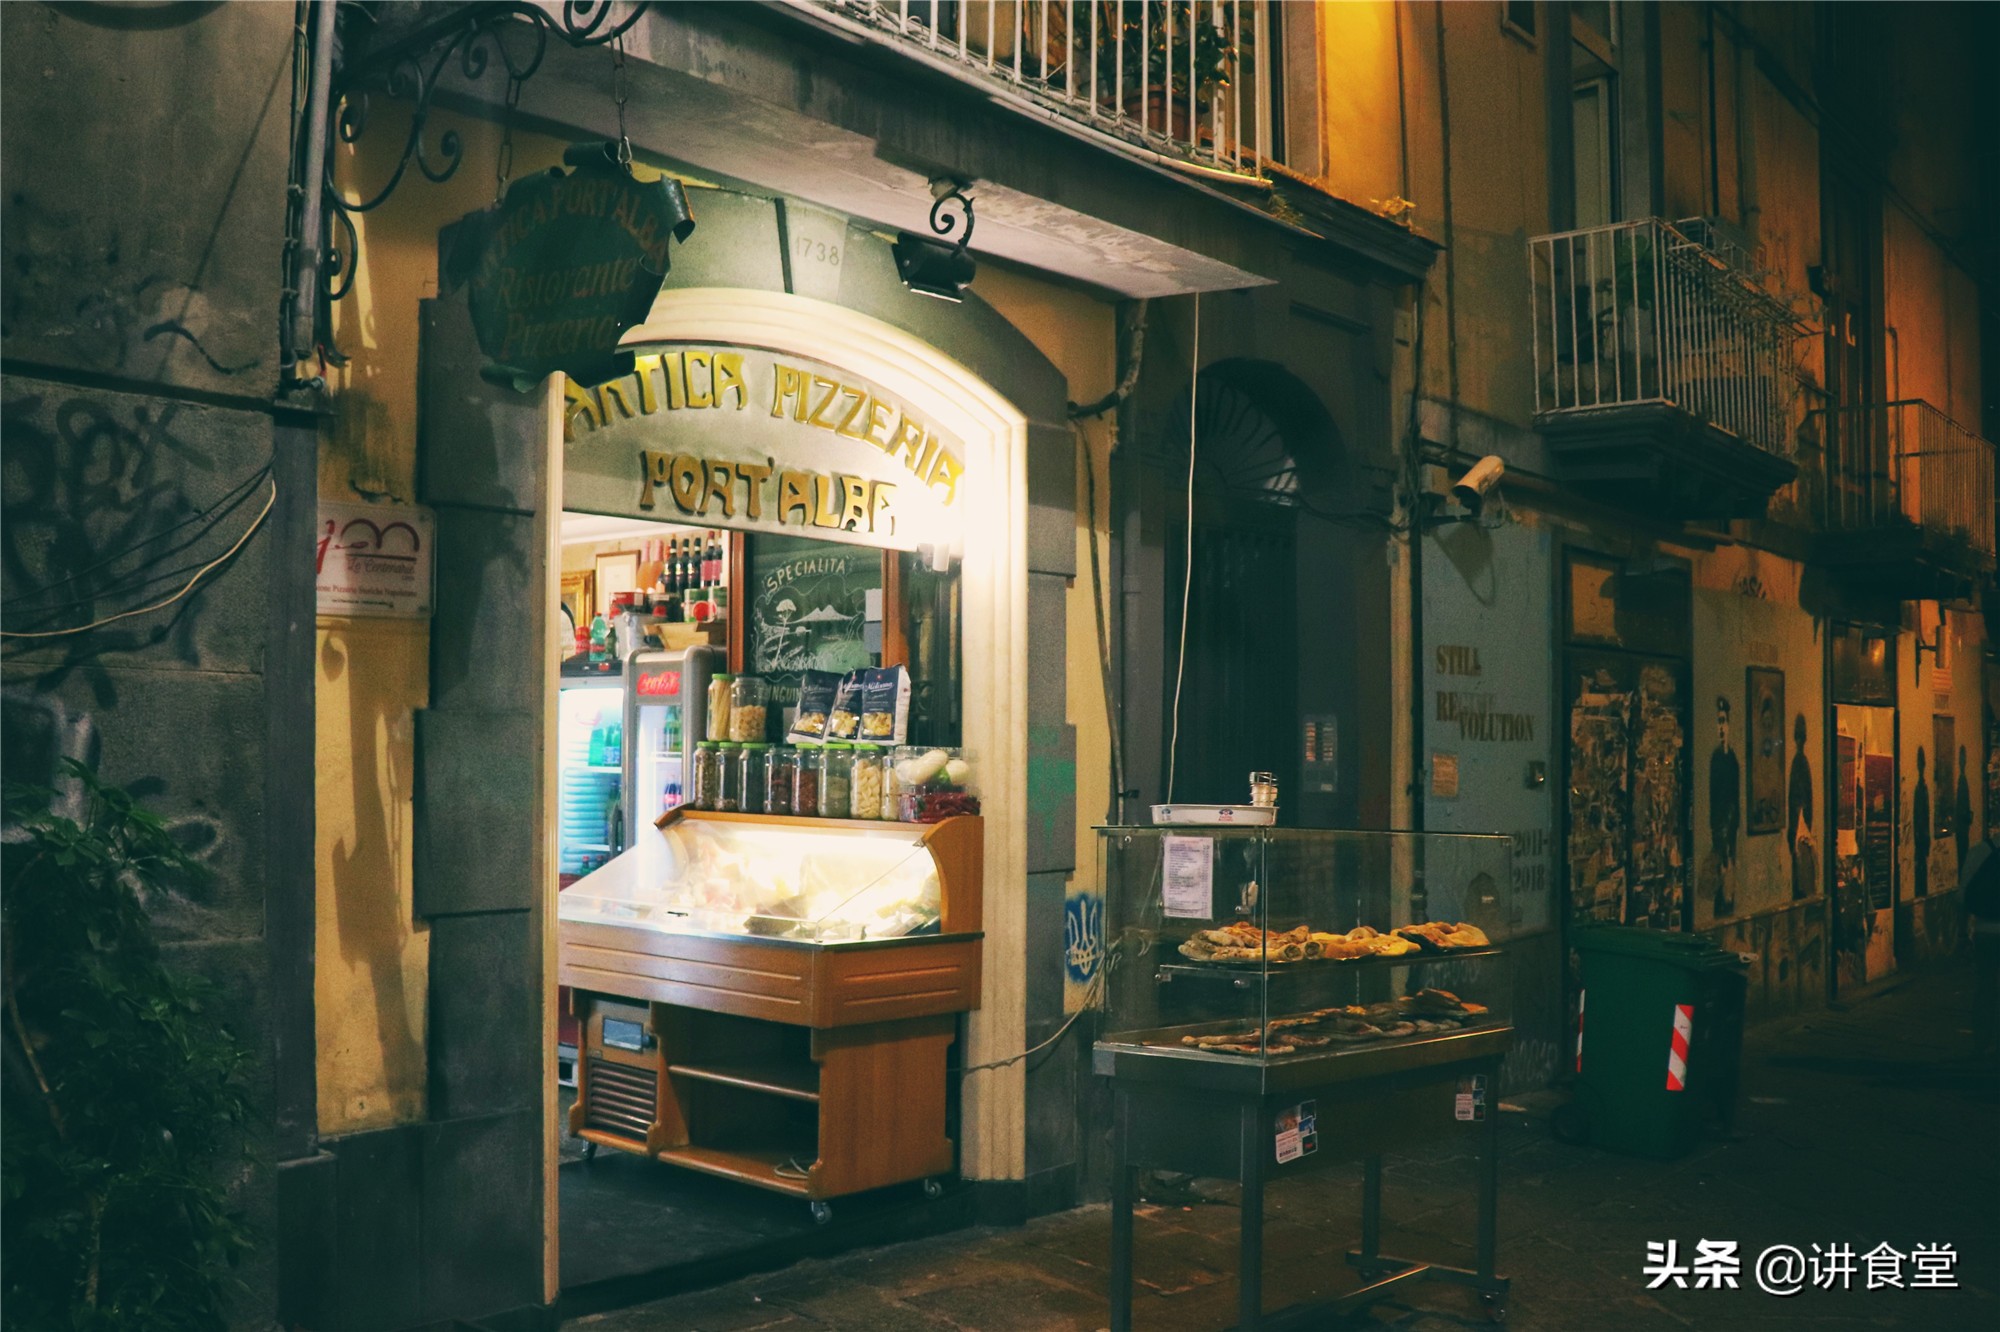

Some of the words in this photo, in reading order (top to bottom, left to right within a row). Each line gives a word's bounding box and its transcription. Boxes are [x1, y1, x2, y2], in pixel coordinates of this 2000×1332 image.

[796, 236, 840, 266] 1738
[496, 256, 638, 312] Ristorante
[502, 312, 618, 361] Pizzeria
[564, 351, 749, 442] ANTICA
[771, 363, 966, 507] PIZZERIA
[640, 449, 898, 537] PORT'ALBA
[1435, 644, 1482, 677] STILL
